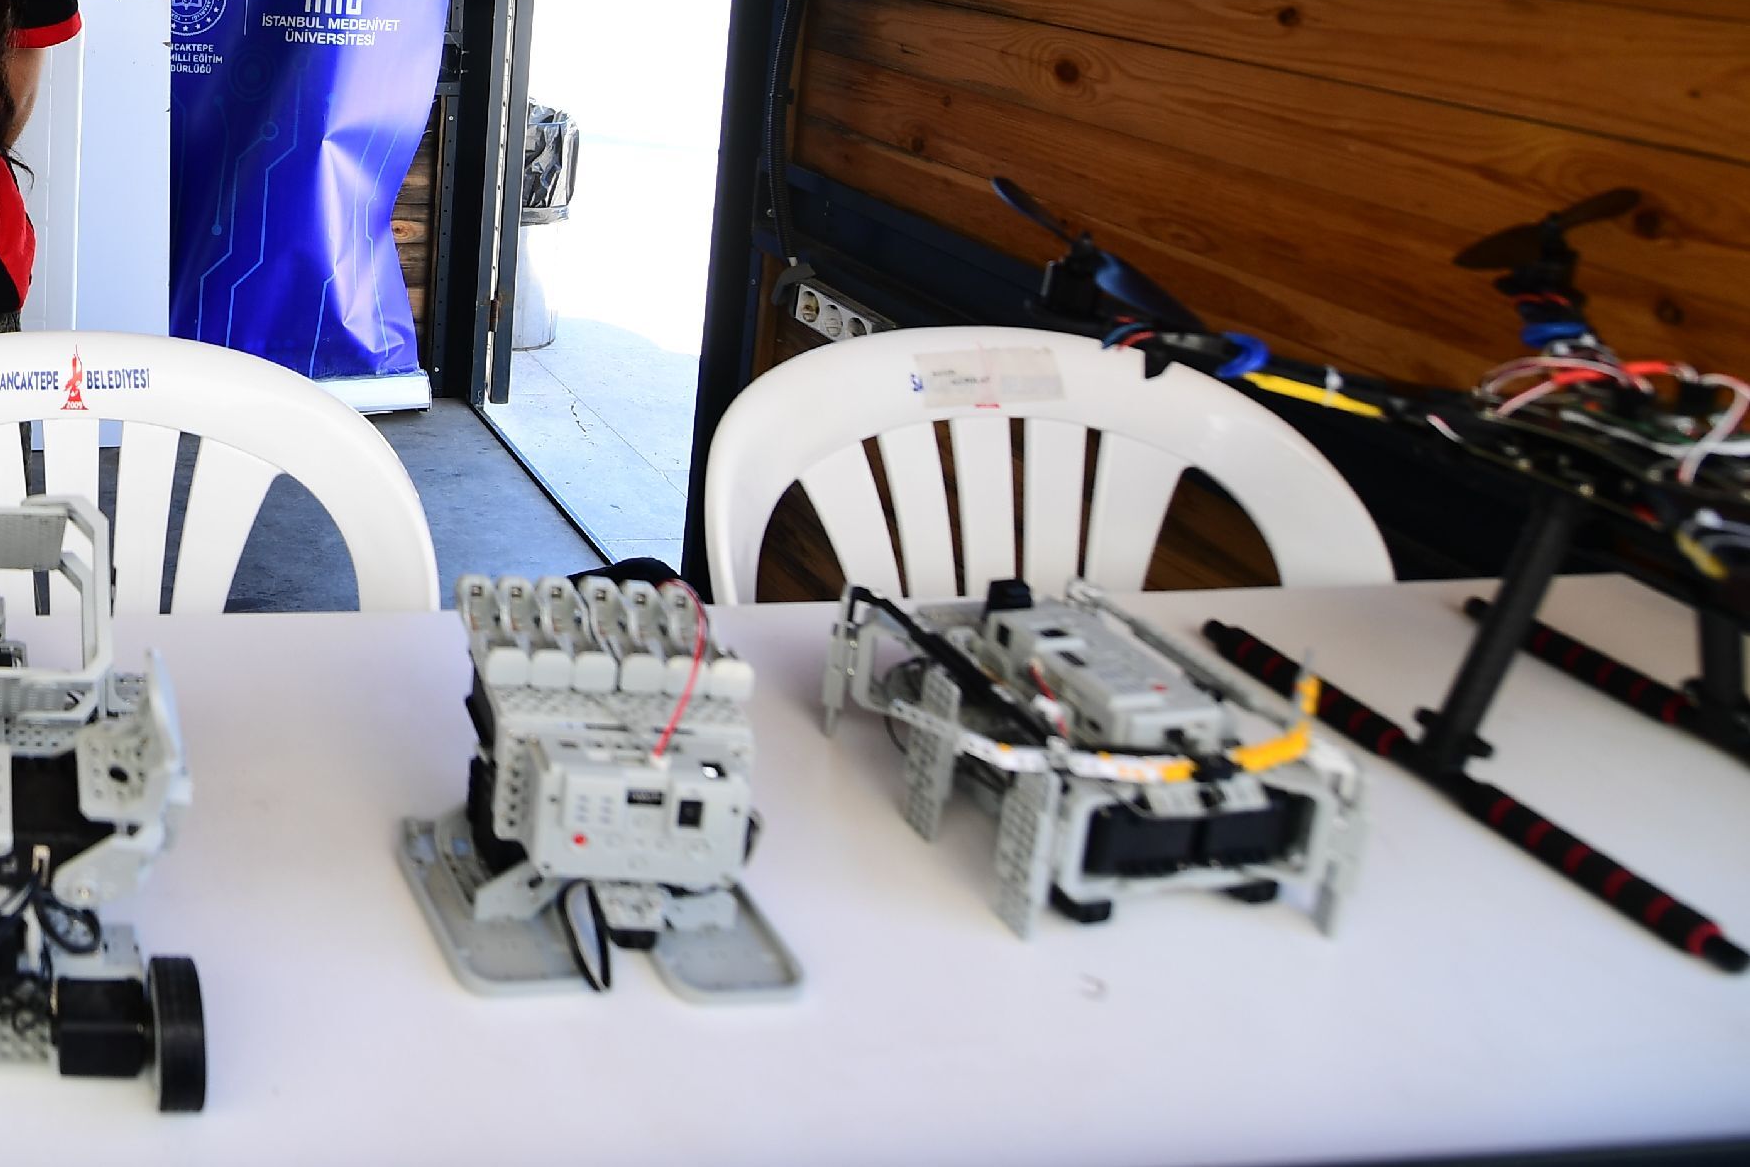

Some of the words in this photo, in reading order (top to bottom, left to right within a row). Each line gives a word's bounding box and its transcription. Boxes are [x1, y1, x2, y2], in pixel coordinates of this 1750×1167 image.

[261, 13, 324, 28] İSTANBUL
[327, 16, 400, 32] MEDENİYET
[285, 28, 376, 46] ÜNİVERSİTESİ
[170, 43, 215, 53] NCAKTEPE
[192, 53, 223, 64] EĞİTİM
[170, 63, 212, 74] DÜRLÜĞÜ
[86, 368, 150, 390] BELEDİYESİ
